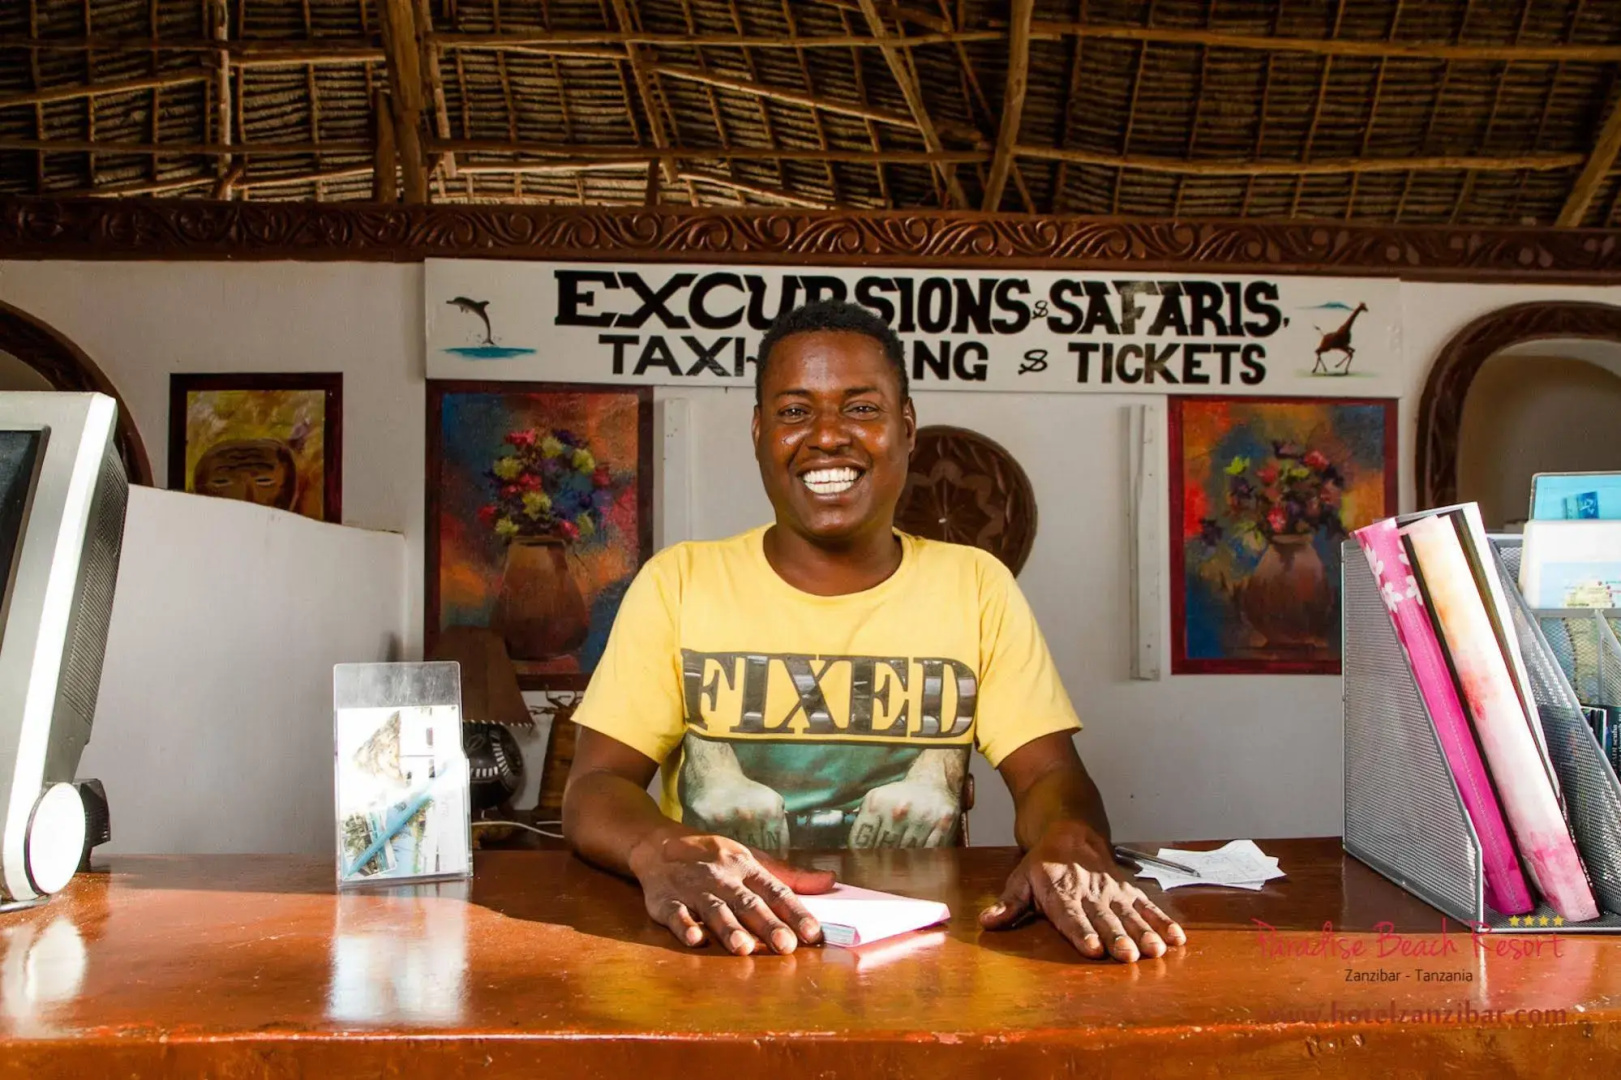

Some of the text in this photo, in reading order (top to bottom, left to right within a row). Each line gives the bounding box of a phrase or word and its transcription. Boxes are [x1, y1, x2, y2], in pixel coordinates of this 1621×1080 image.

[1047, 279, 1290, 338] SAFARIS,
[1018, 349, 1048, 376] &
[1068, 342, 1266, 385] TICKETS
[680, 648, 978, 739] FIXED
